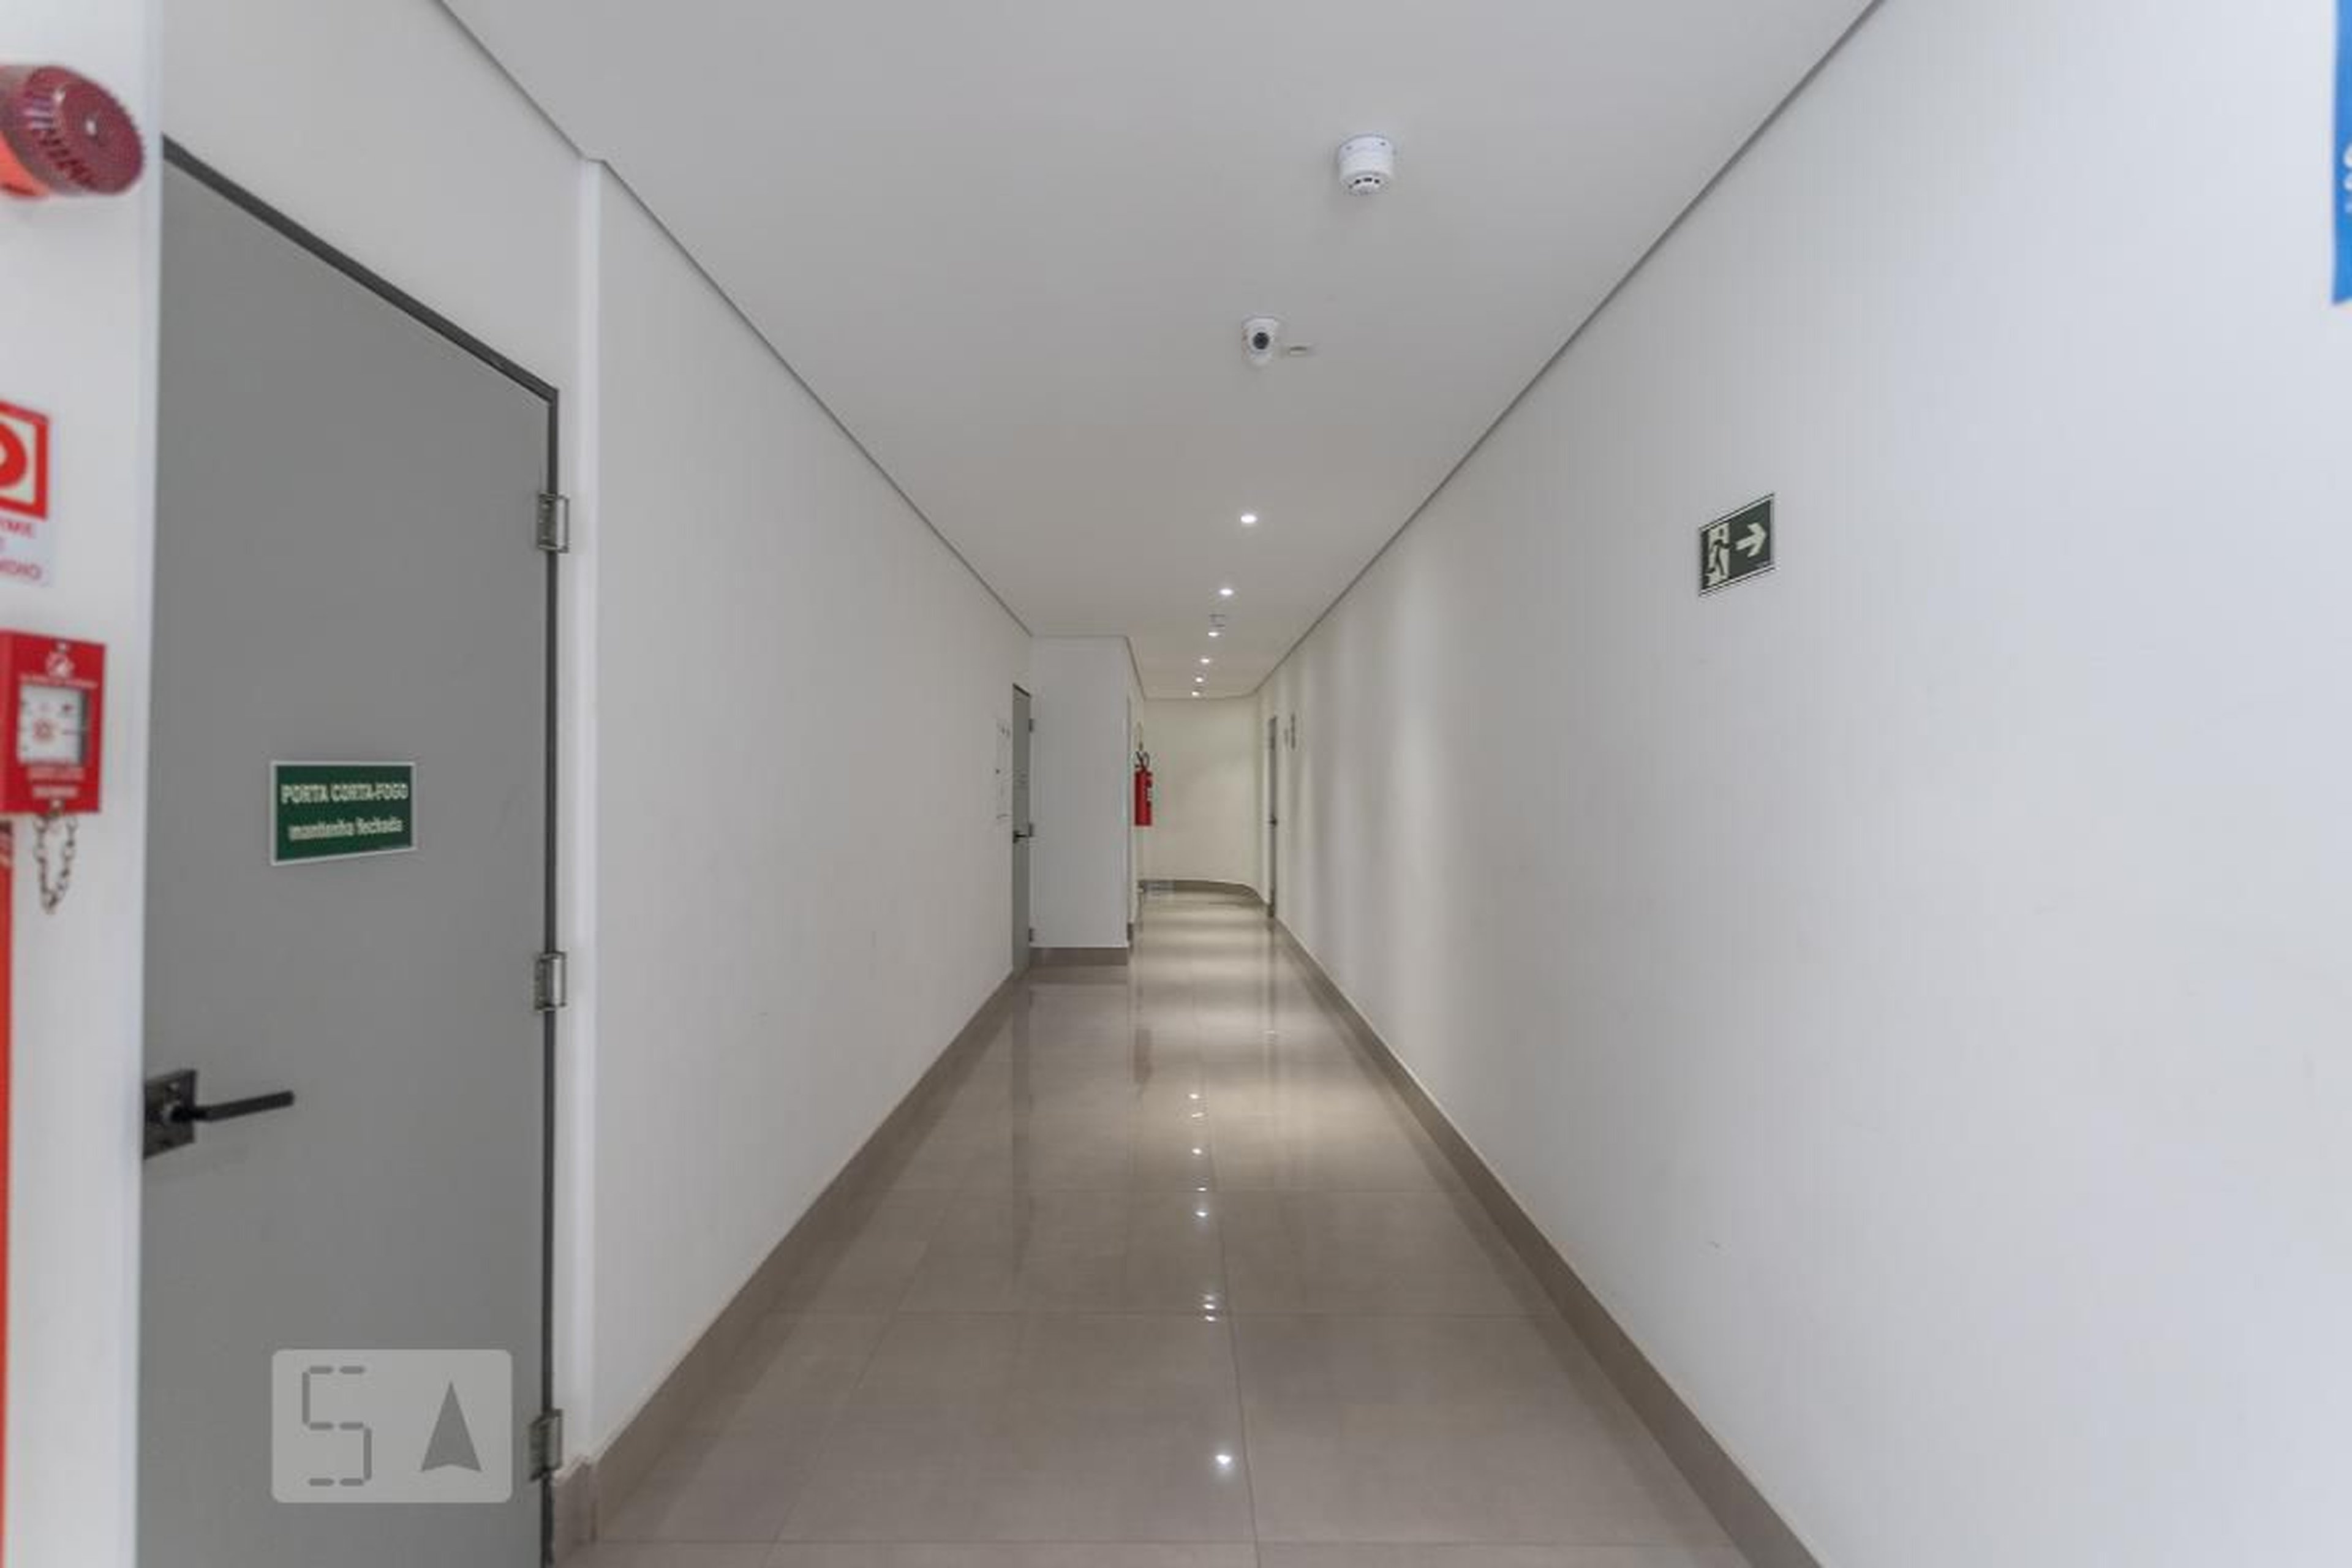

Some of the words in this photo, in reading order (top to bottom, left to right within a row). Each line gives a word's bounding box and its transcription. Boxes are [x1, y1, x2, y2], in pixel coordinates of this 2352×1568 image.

[281, 784, 328, 804] PORTA
[331, 783, 409, 802] CORTA-FOGO
[288, 820, 354, 842] mantenha
[356, 816, 402, 835] fechada
